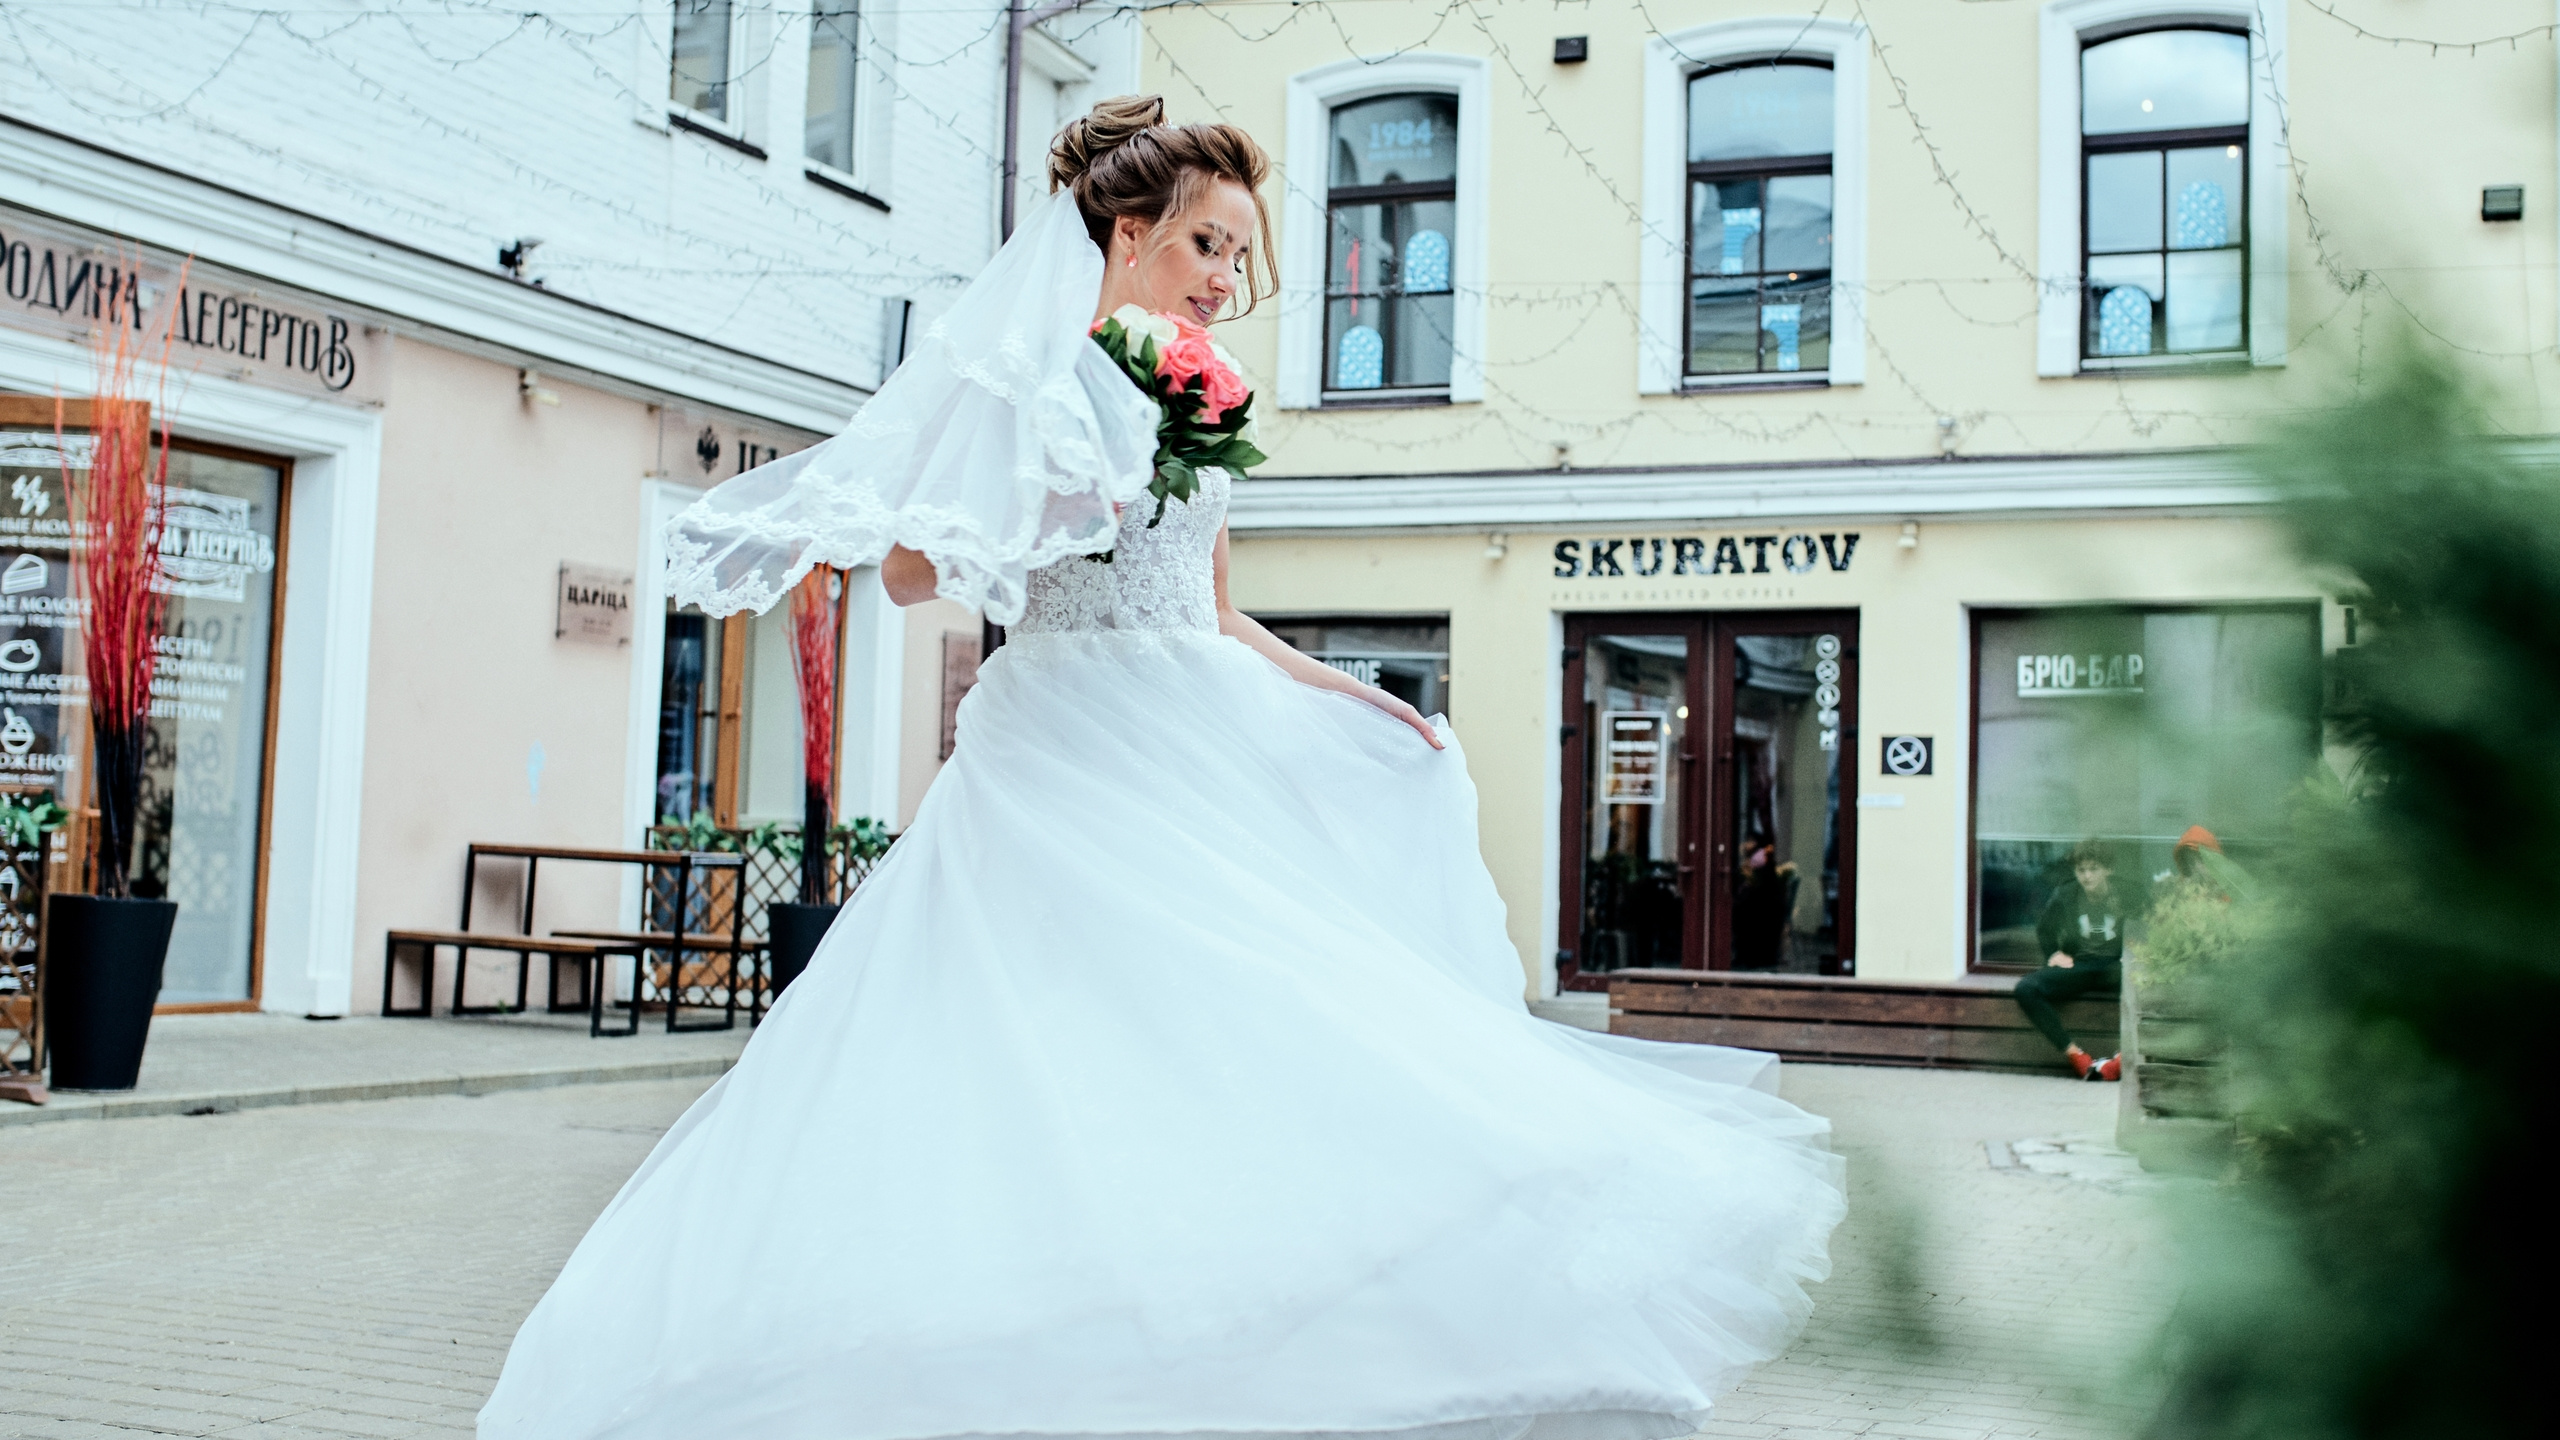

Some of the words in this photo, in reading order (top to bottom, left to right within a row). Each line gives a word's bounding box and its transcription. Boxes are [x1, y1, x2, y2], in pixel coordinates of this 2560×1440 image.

[1368, 118, 1434, 149] 1984
[163, 285, 356, 392] ДЕСЕРТОВ
[1554, 533, 1860, 578] SKURATOV
[0, 673, 25, 689] ЫЕ
[141, 655, 247, 684] СТОРИЧЕСКИ
[2017, 653, 2145, 689] БРЮ-БАР
